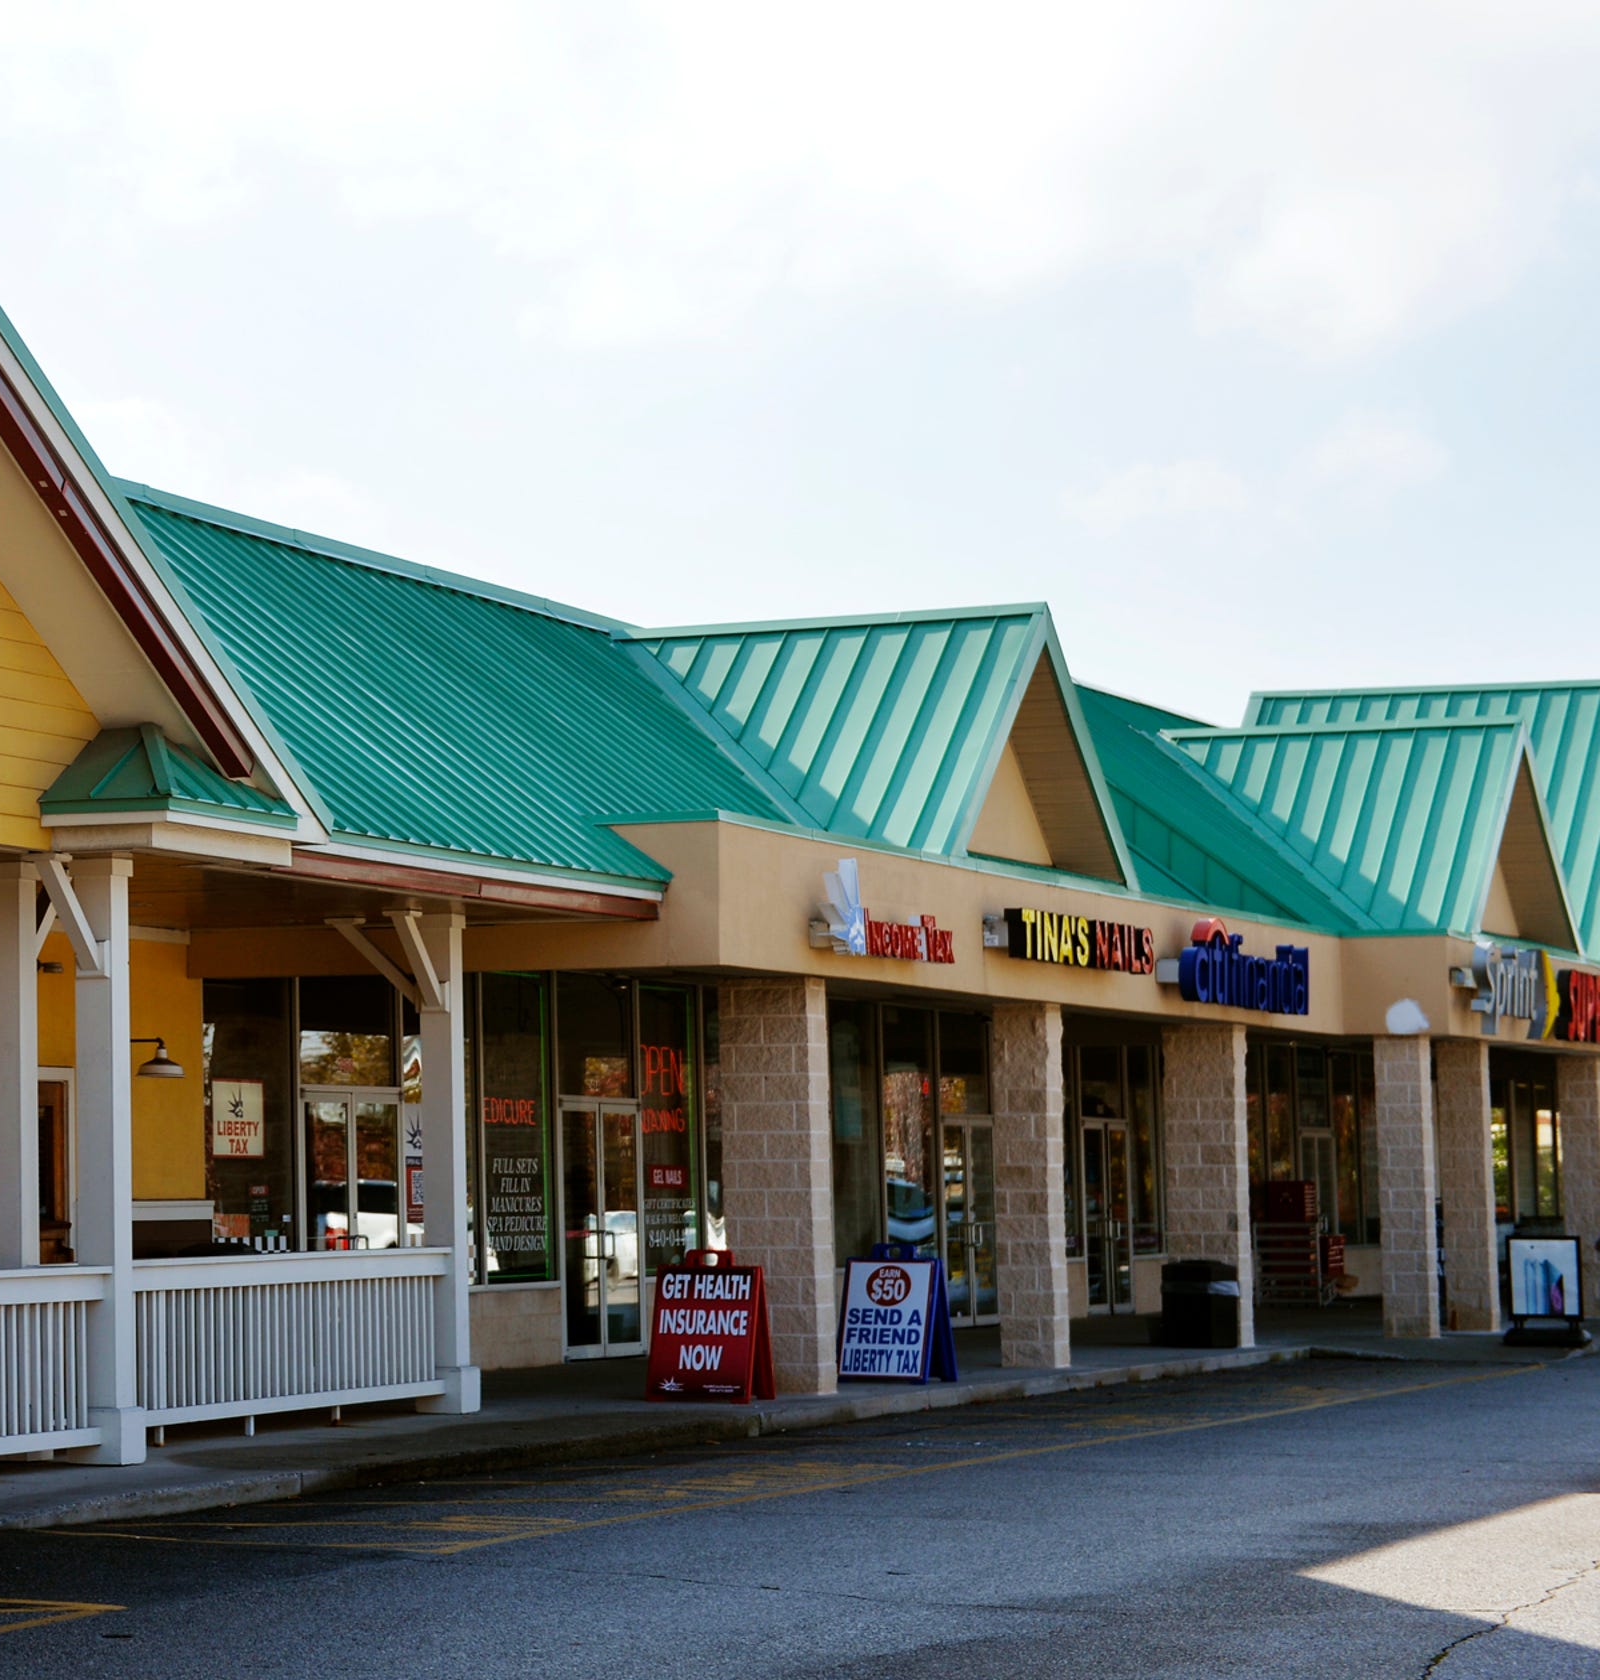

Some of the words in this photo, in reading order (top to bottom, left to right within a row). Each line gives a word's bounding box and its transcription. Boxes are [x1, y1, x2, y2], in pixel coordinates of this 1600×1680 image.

[1020, 907, 1090, 967] TINA'S
[1094, 919, 1154, 975] NAILS
[1475, 941, 1539, 1035] Sprint
[483, 1097, 537, 1126] EDICURE
[216, 1120, 260, 1137] LIBERTY
[228, 1138, 249, 1154] TAX
[492, 1158, 515, 1175] FULL
[515, 1157, 539, 1175] SETS
[500, 1177, 519, 1193] FILL
[520, 1177, 532, 1193] IN
[490, 1196, 543, 1213] MANICURES
[879, 1268, 901, 1278] EARN
[661, 1272, 691, 1300] GET
[693, 1273, 751, 1300] HEALTH
[871, 1277, 906, 1302] $50
[658, 1308, 749, 1336] INSURANCE
[846, 1307, 903, 1326] SEND
[907, 1308, 922, 1326] A
[845, 1327, 920, 1345] FRIEND
[678, 1343, 723, 1371] NOW
[841, 1348, 893, 1373] LIBERTY
[896, 1349, 920, 1374] TAX
